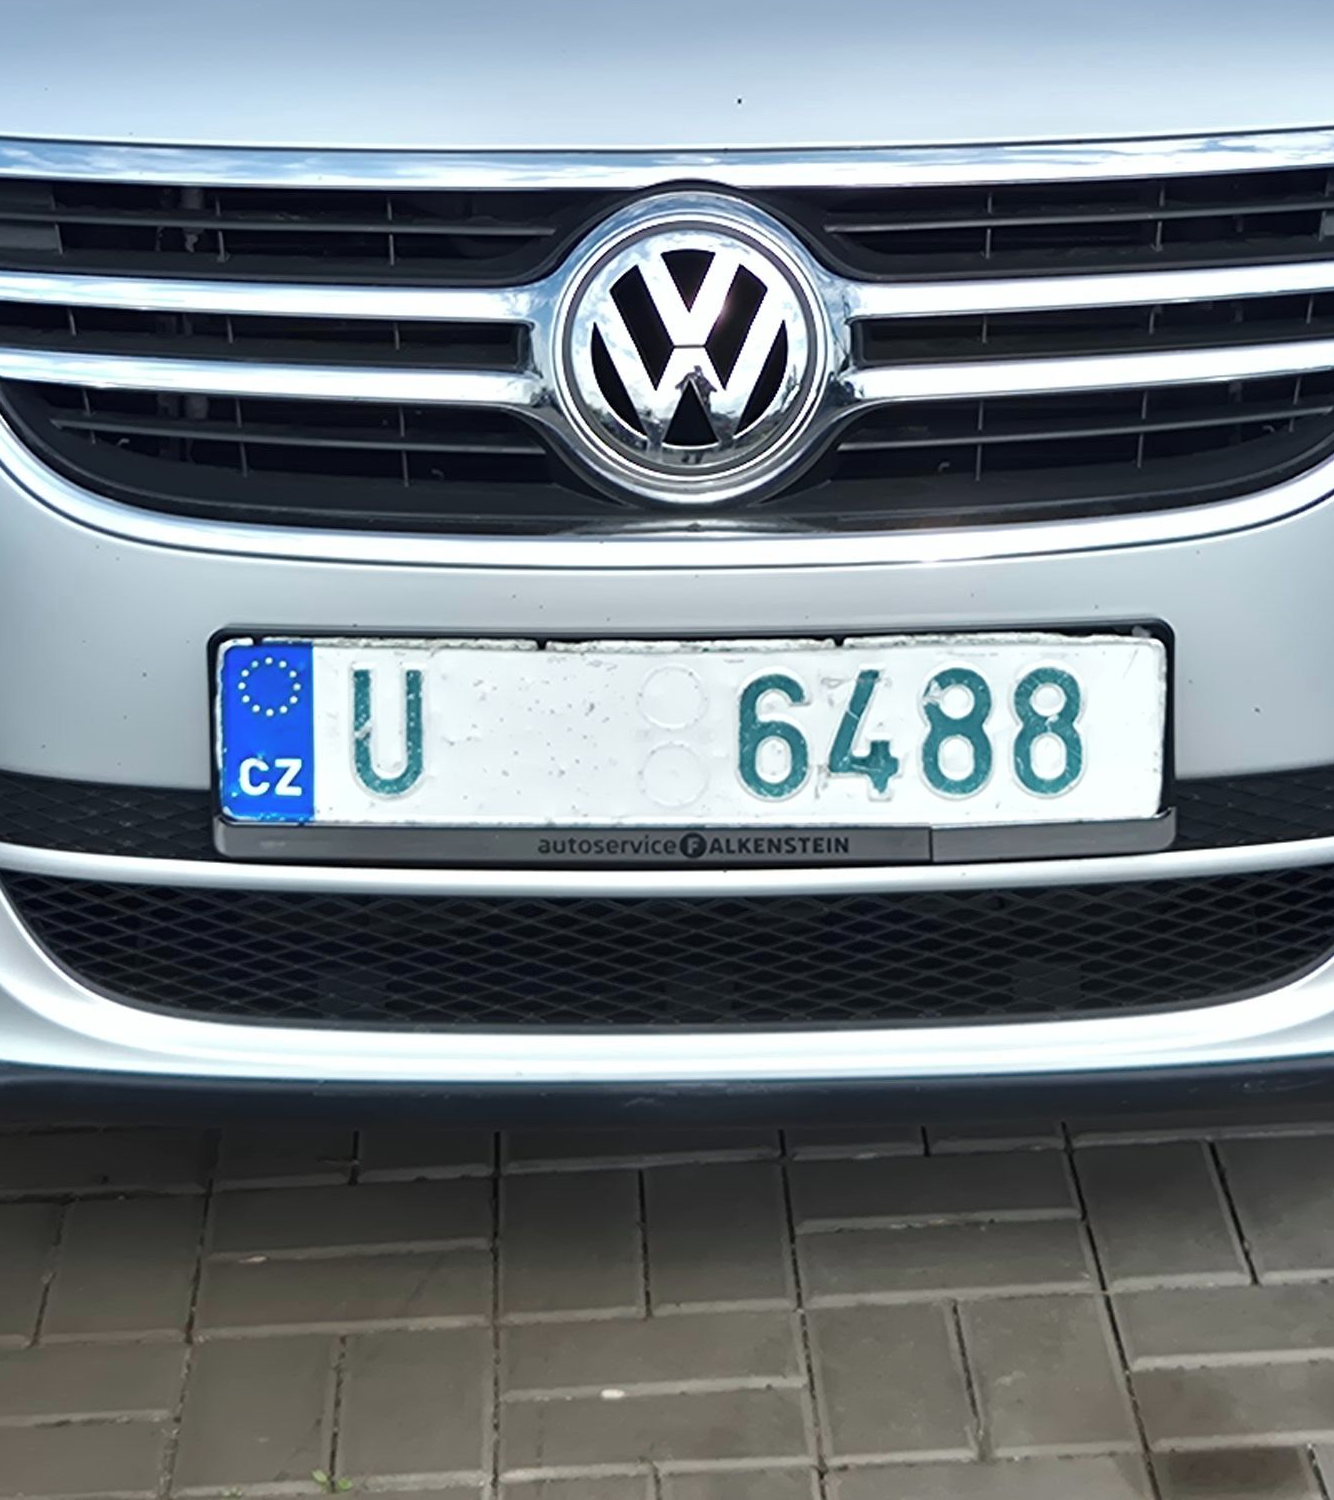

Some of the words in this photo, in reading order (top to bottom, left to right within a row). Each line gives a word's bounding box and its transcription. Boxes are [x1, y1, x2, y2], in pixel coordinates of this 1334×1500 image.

[572, 232, 808, 465] VW
[351, 666, 423, 796] U
[738, 666, 1083, 798] 6488
[240, 757, 302, 796] CZ
[538, 834, 677, 855] autoservice
